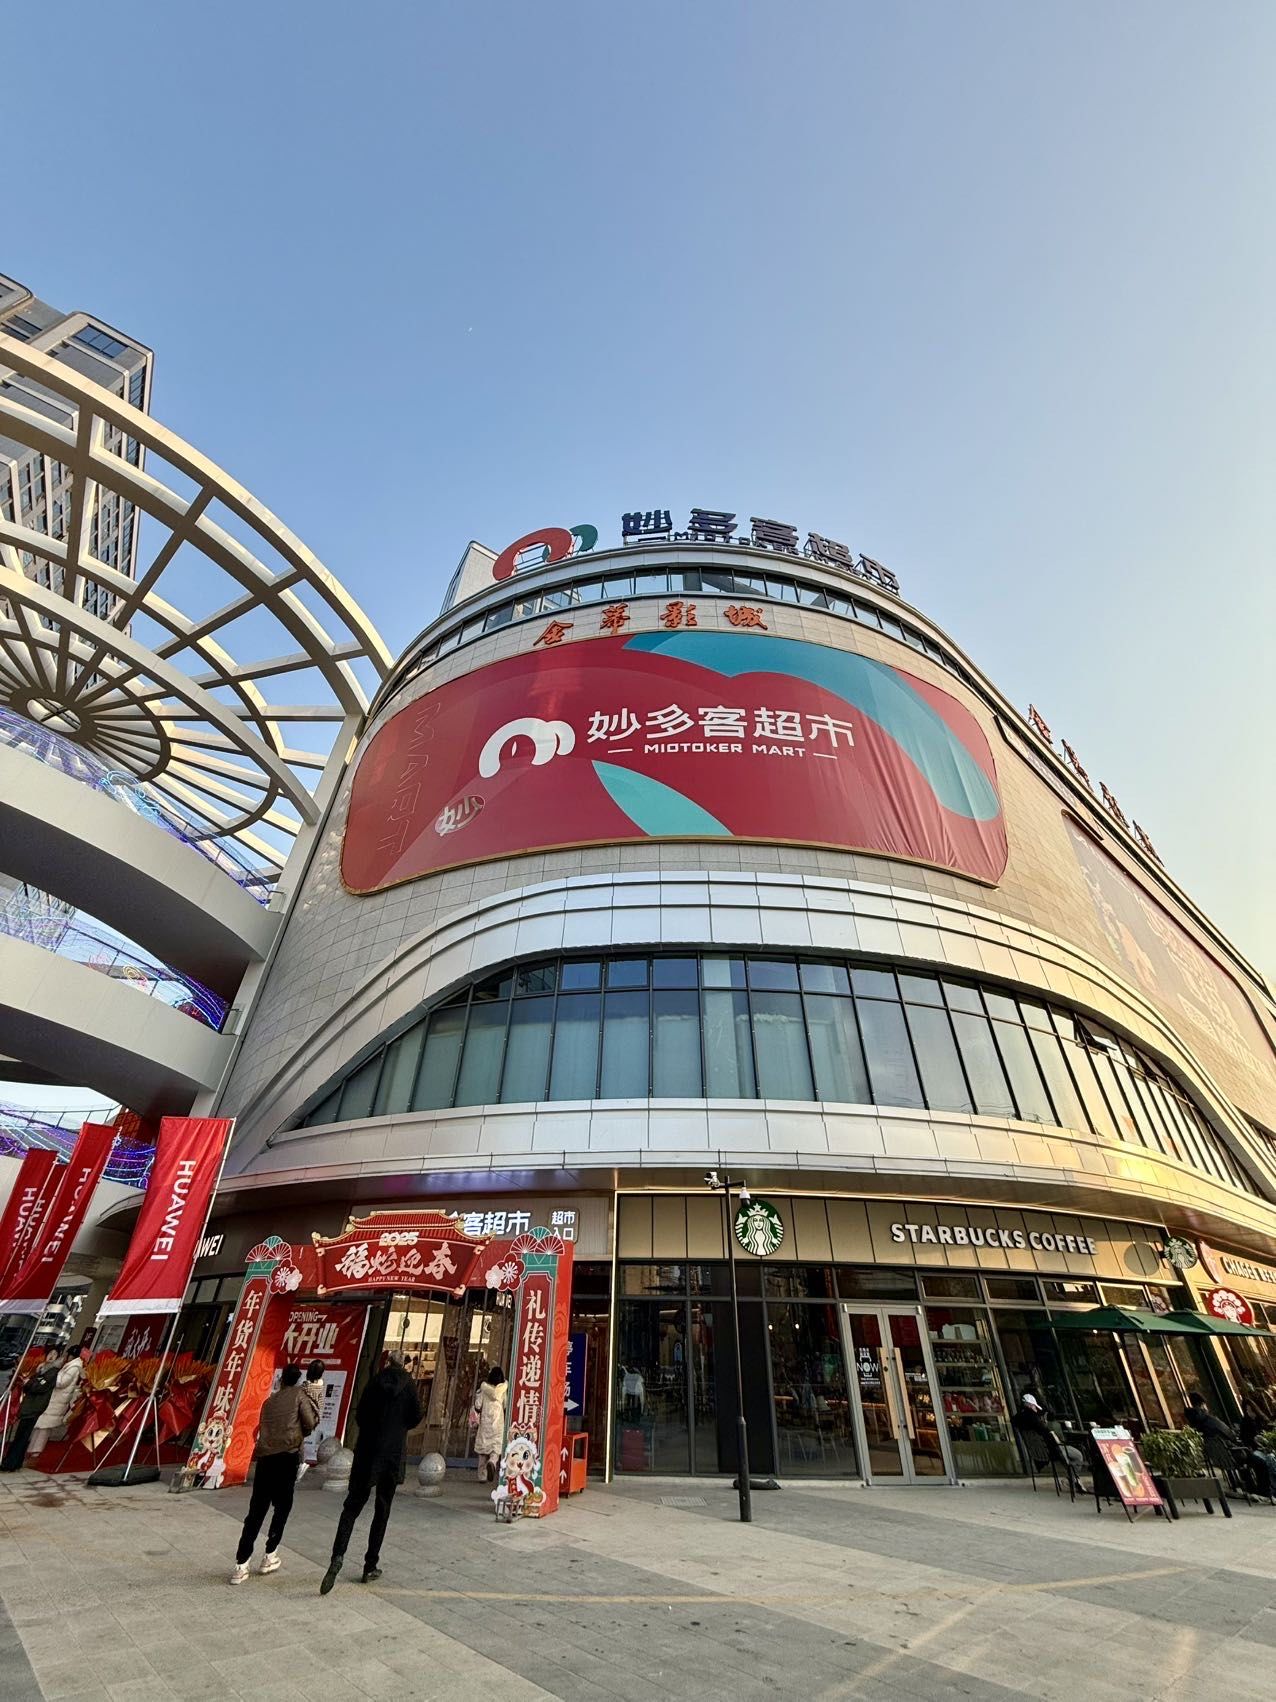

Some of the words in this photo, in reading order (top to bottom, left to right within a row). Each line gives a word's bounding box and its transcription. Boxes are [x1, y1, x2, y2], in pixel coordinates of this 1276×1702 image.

[587, 703, 855, 748] 妙多客超市
[644, 743, 743, 754] MIOTOKER
[752, 744, 806, 758] MART
[438, 796, 482, 837] 妙
[150, 1160, 197, 1260] HUAWEI
[552, 1211, 576, 1225] 超市
[379, 1231, 420, 1246] 2025
[552, 1227, 574, 1240] 入口
[891, 1223, 1026, 1249] STARBUCKS
[1029, 1231, 1099, 1254] COFFEE
[334, 1241, 458, 1281] 福蛇迎春
[288, 1311, 319, 1322] OPENING
[212, 1289, 263, 1415] 年货年味
[516, 1289, 546, 1424] 礼传递情
